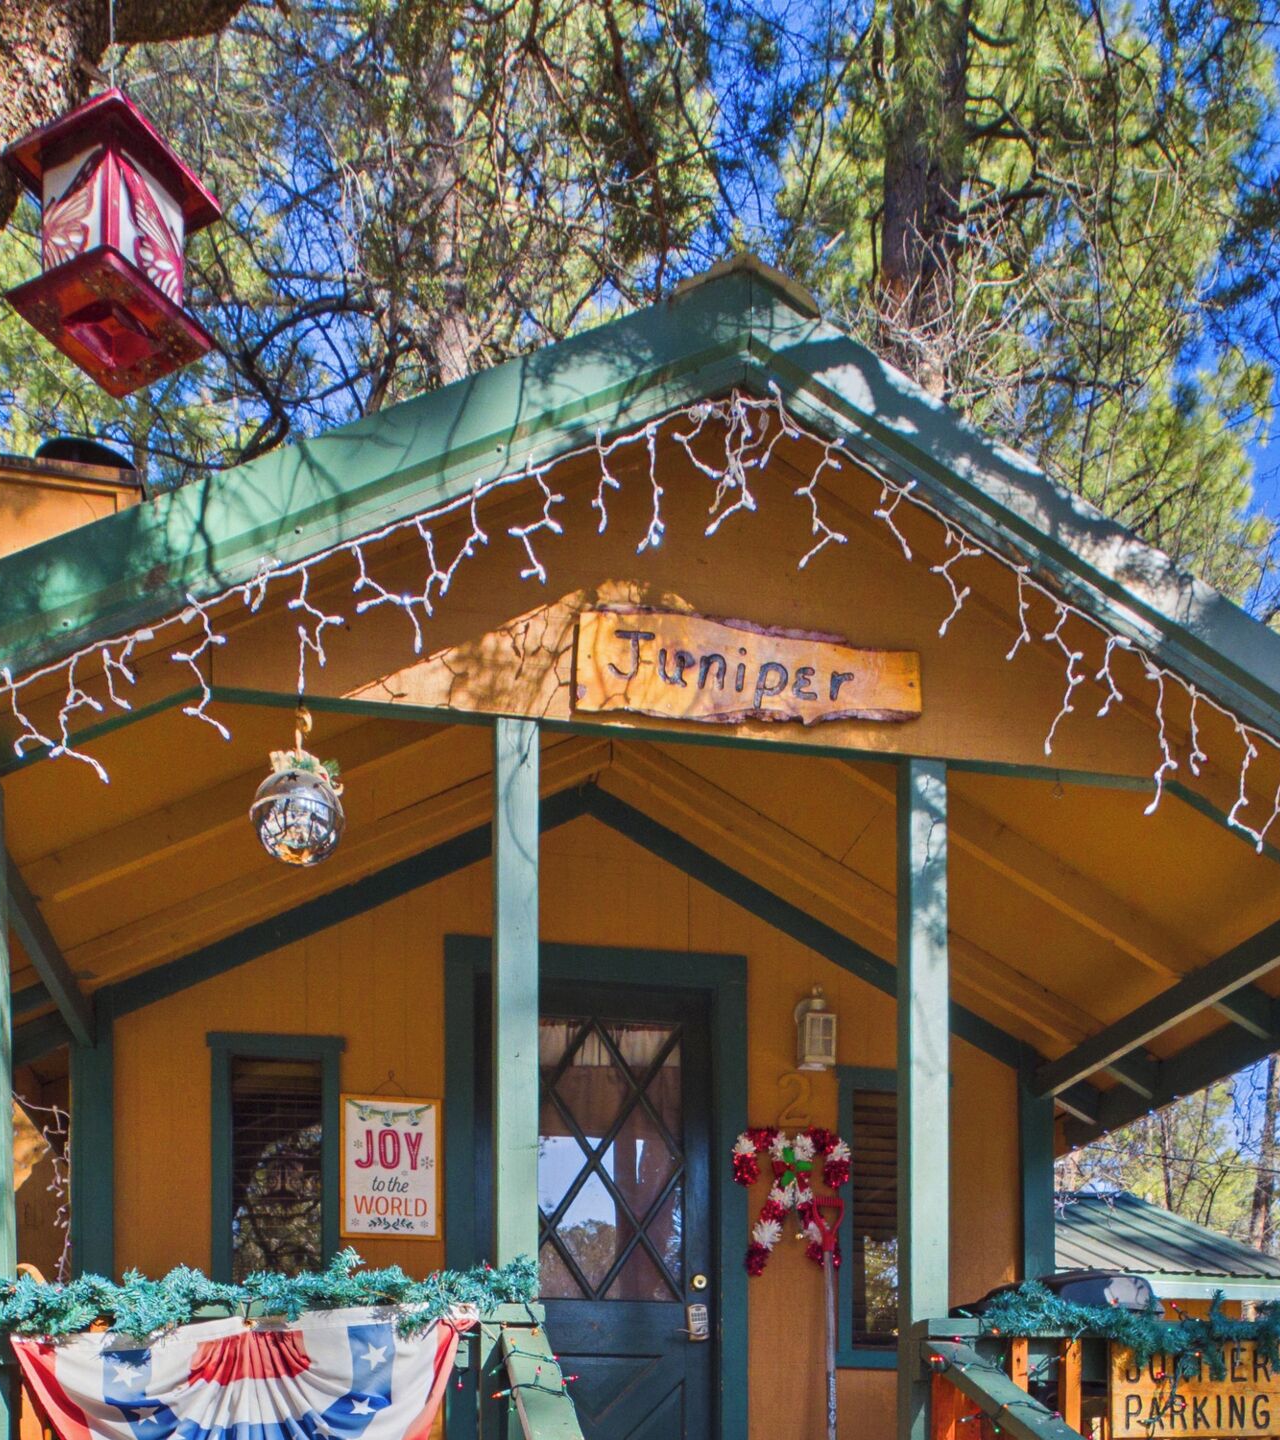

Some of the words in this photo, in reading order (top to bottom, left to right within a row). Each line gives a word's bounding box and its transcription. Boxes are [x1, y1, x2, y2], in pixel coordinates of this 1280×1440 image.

[607, 629, 855, 709] Juniper
[777, 1072, 810, 1128] 2
[354, 1129, 423, 1171] JOY
[372, 1176, 386, 1192] to
[387, 1176, 409, 1193] the
[353, 1195, 428, 1217] WORLD
[1124, 1394, 1271, 1430] PARKING
